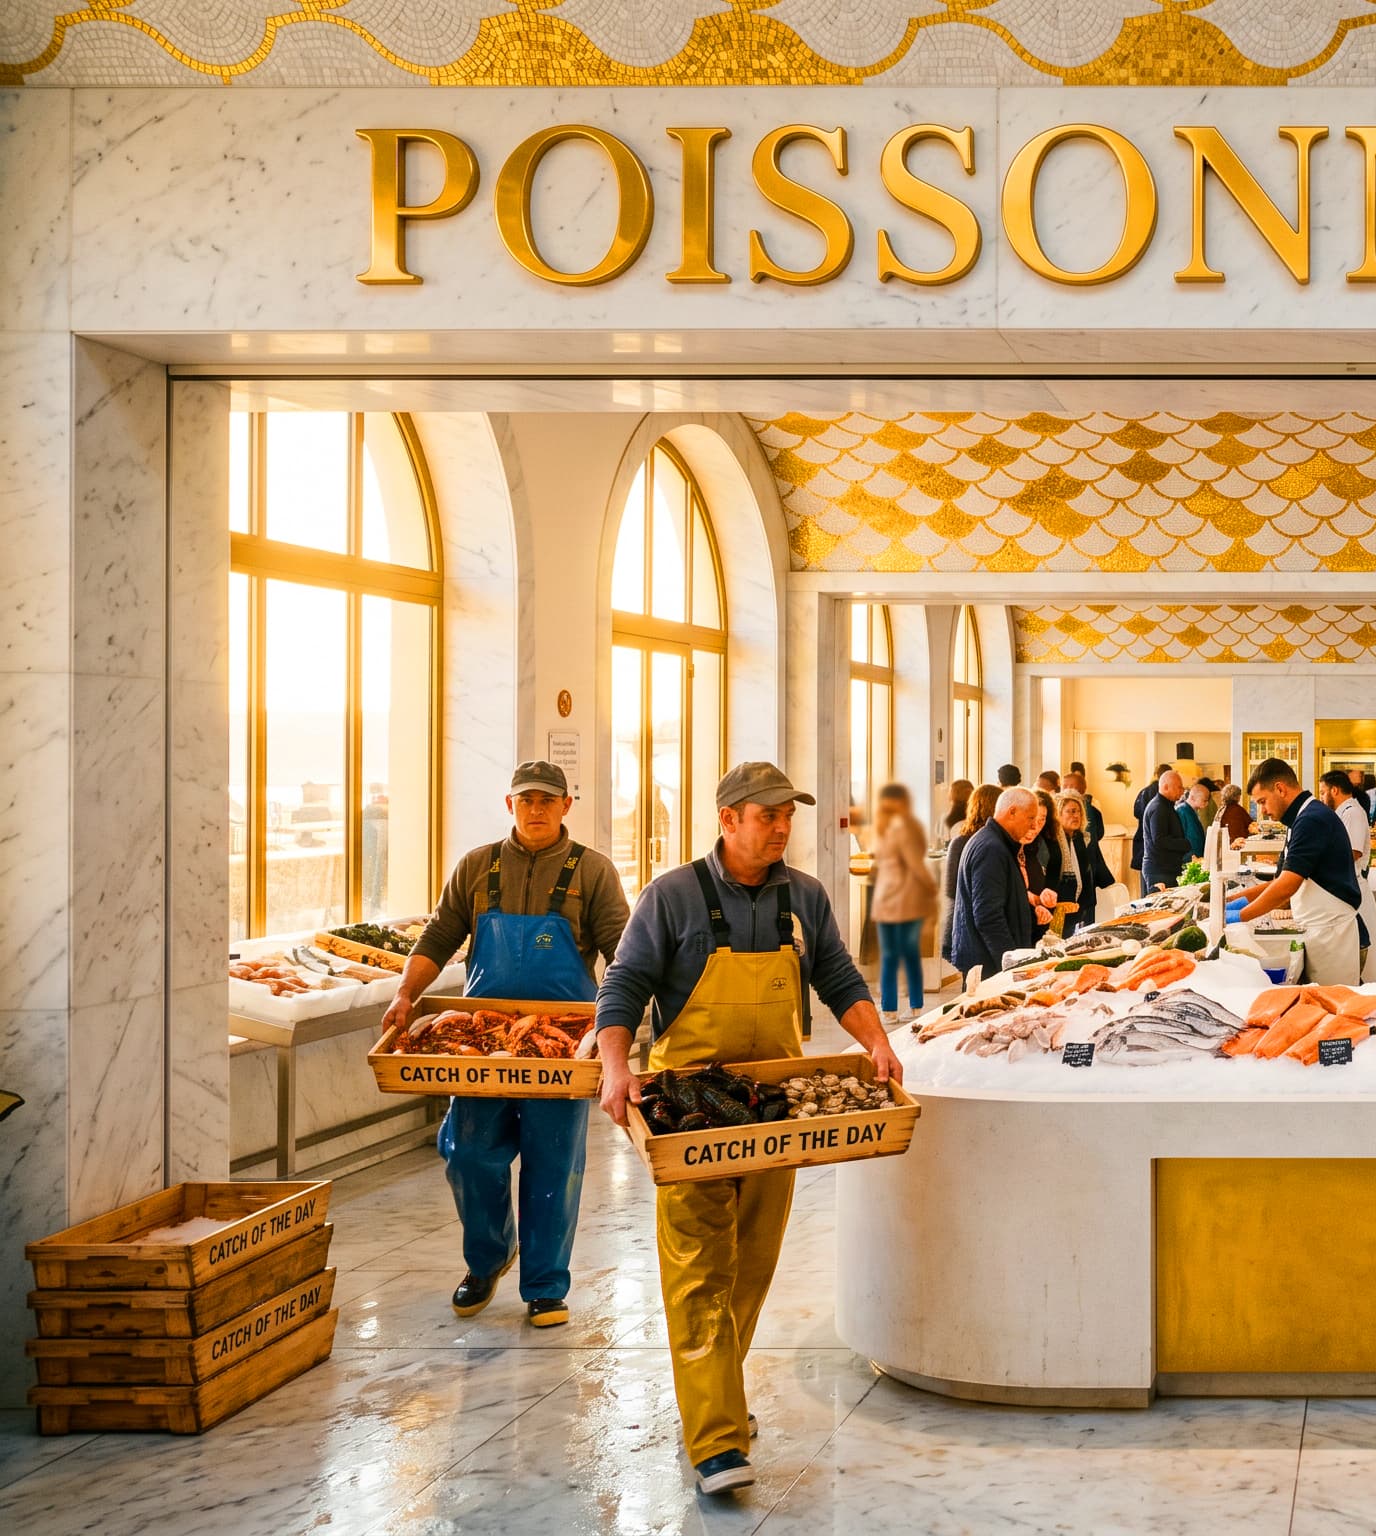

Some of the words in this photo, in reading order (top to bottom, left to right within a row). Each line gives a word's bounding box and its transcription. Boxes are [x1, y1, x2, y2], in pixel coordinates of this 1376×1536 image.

[400, 1066, 460, 1083] CATCH
[466, 1067, 490, 1084] OF
[496, 1068, 532, 1084] THE
[538, 1070, 573, 1085] DAY
[684, 1138, 756, 1166] CATCH
[763, 1134, 791, 1156] OF
[798, 1128, 839, 1151] THE
[846, 1122, 887, 1145] DAY
[209, 1231, 248, 1265] CATCH
[251, 1222, 266, 1245] OF
[270, 1210, 292, 1236] THE
[295, 1198, 316, 1224] DAY
[212, 1323, 251, 1360] CATCH
[255, 1312, 271, 1336] OF
[274, 1299, 296, 1326] THE
[300, 1285, 321, 1312] DAY
